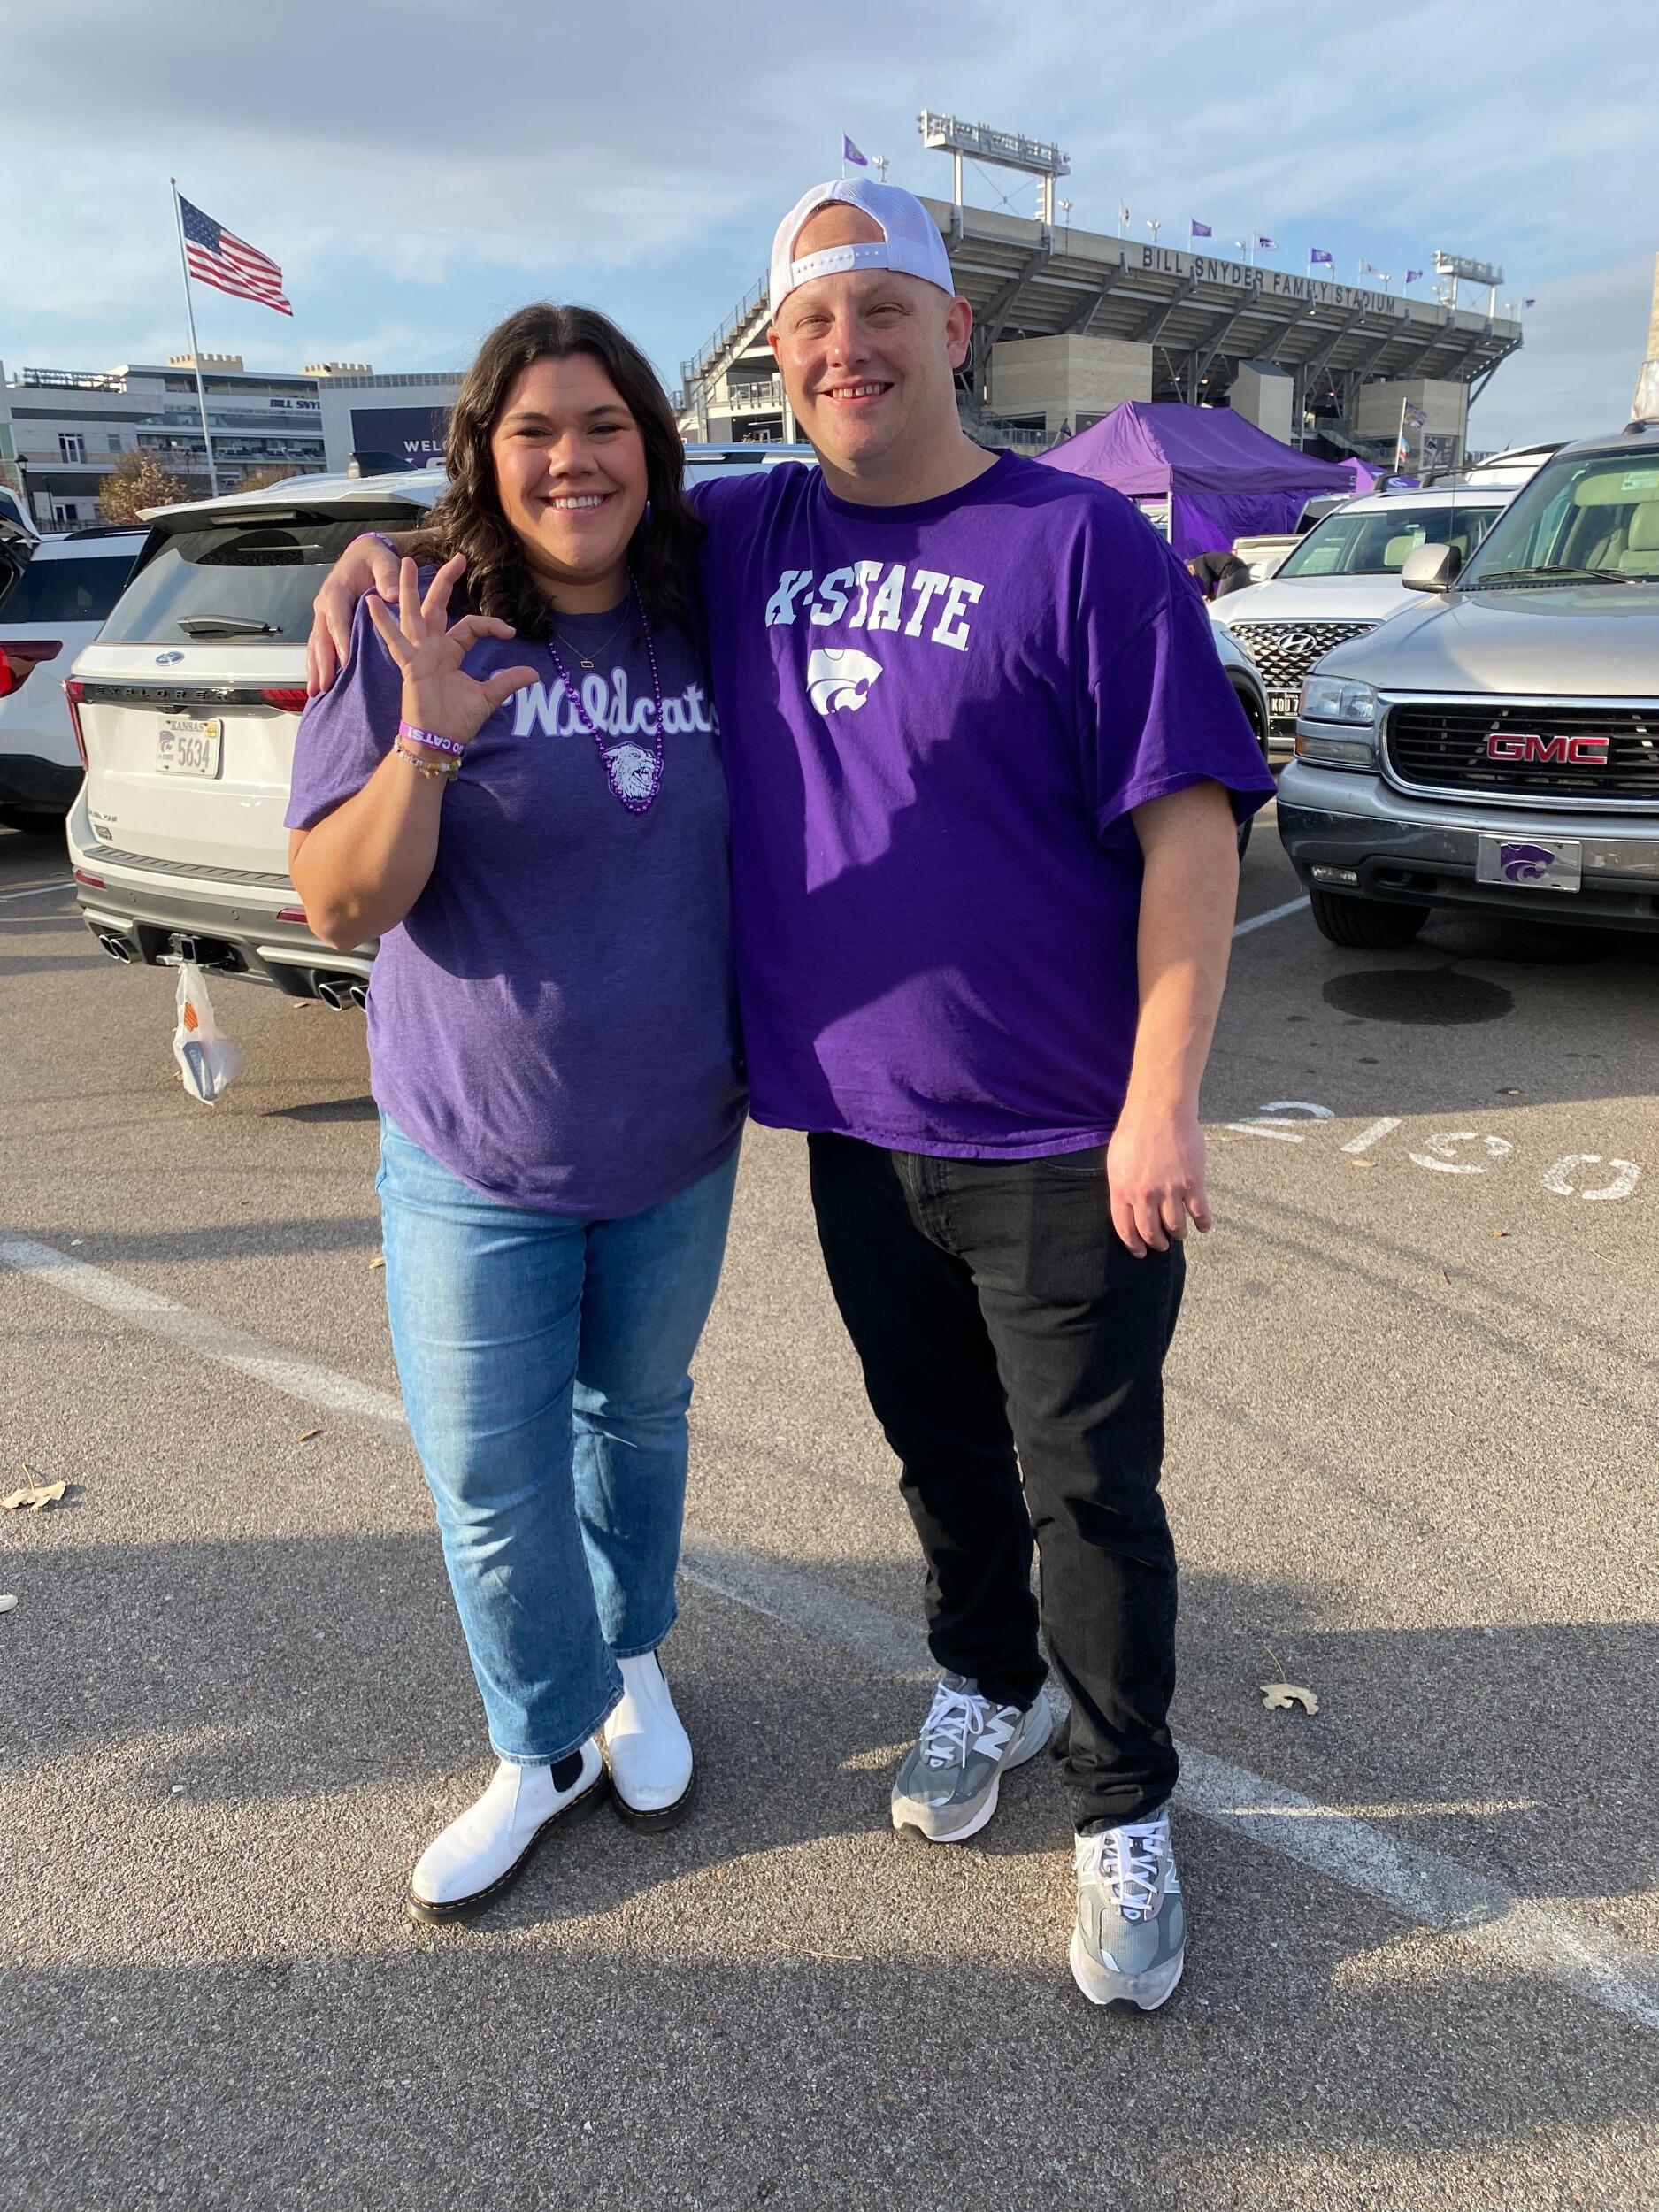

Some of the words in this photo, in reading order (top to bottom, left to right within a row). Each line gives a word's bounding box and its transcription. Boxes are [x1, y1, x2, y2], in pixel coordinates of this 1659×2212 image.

[1143, 247, 1183, 274] BILL
[1195, 257, 1263, 290] SNYDER
[1274, 273, 1327, 302] FAMILY
[1335, 286, 1395, 315] STADIUM
[270, 399, 293, 409] BILL
[296, 401, 320, 410] SNY
[765, 560, 985, 651] K-STATE
[96, 687, 233, 700] EXPLORER
[1271, 698, 1291, 711] KQU
[171, 720, 204, 732] KANSAS
[407, 726, 451, 750] CATS!
[178, 737, 210, 768] 5634
[1487, 733, 1610, 764] GMC
